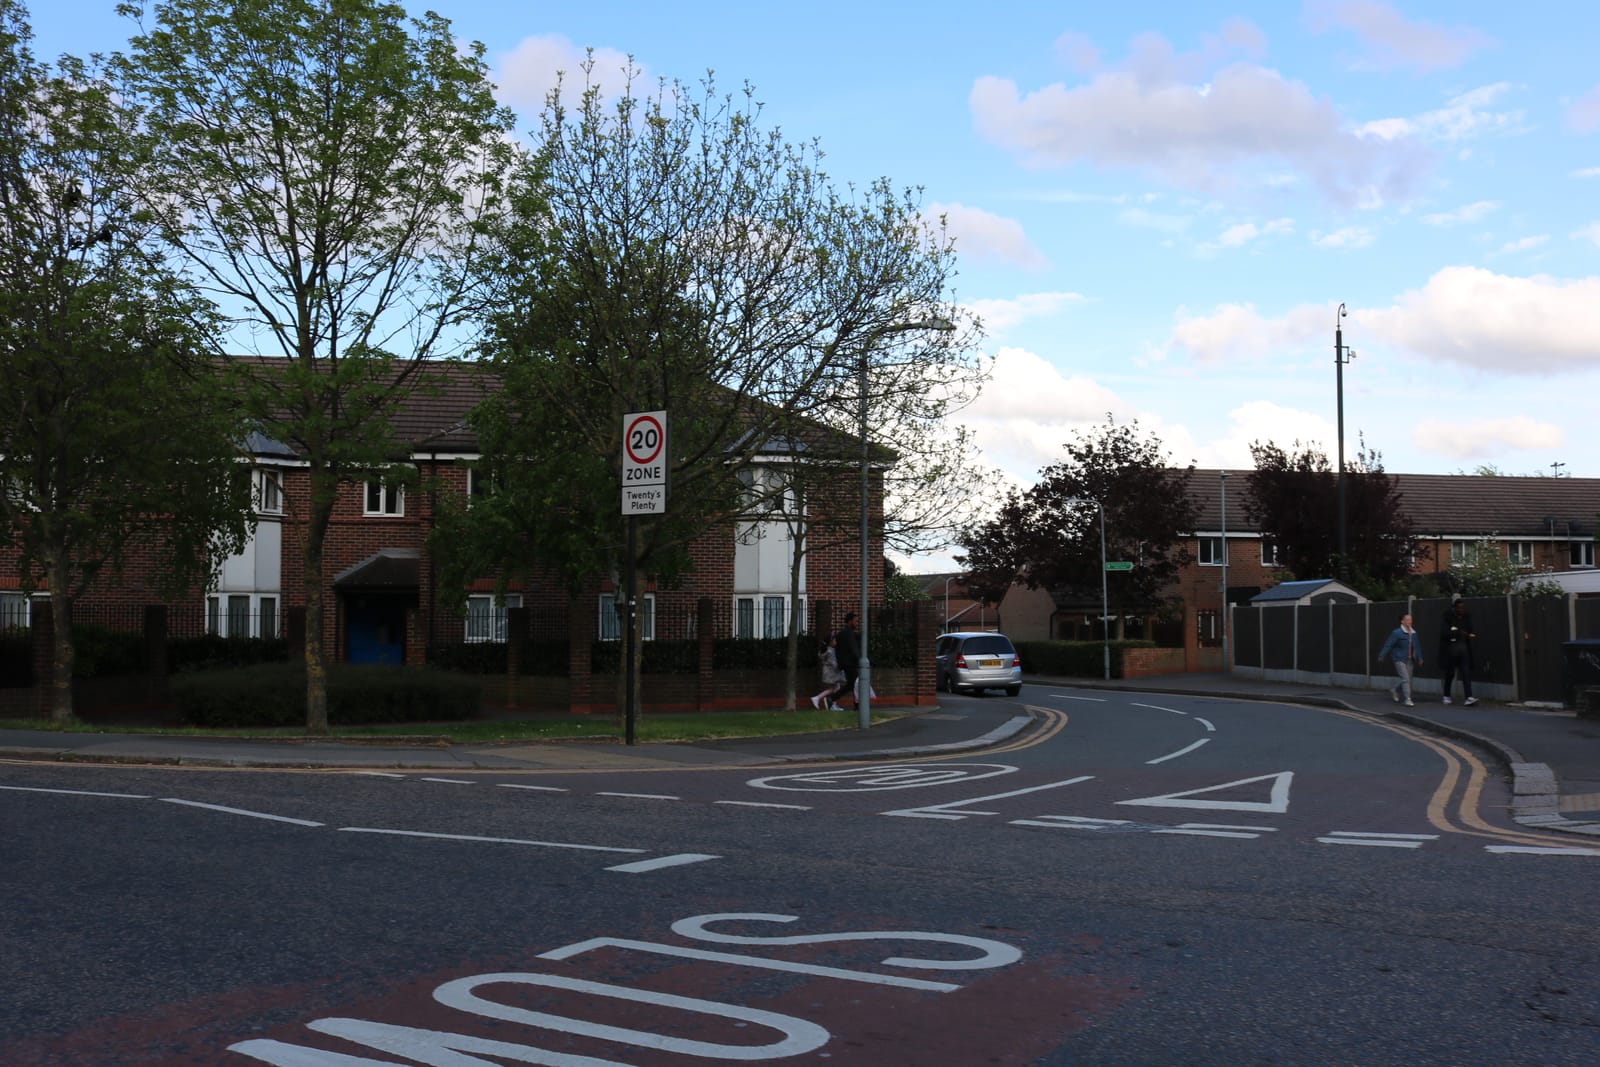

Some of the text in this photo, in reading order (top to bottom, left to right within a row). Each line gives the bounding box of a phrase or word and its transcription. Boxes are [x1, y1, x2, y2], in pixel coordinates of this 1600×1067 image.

[631, 428, 658, 450] 20
[626, 466, 661, 481] ZONE
[626, 490, 661, 500] Twenty's
[631, 501, 657, 511] Plenty
